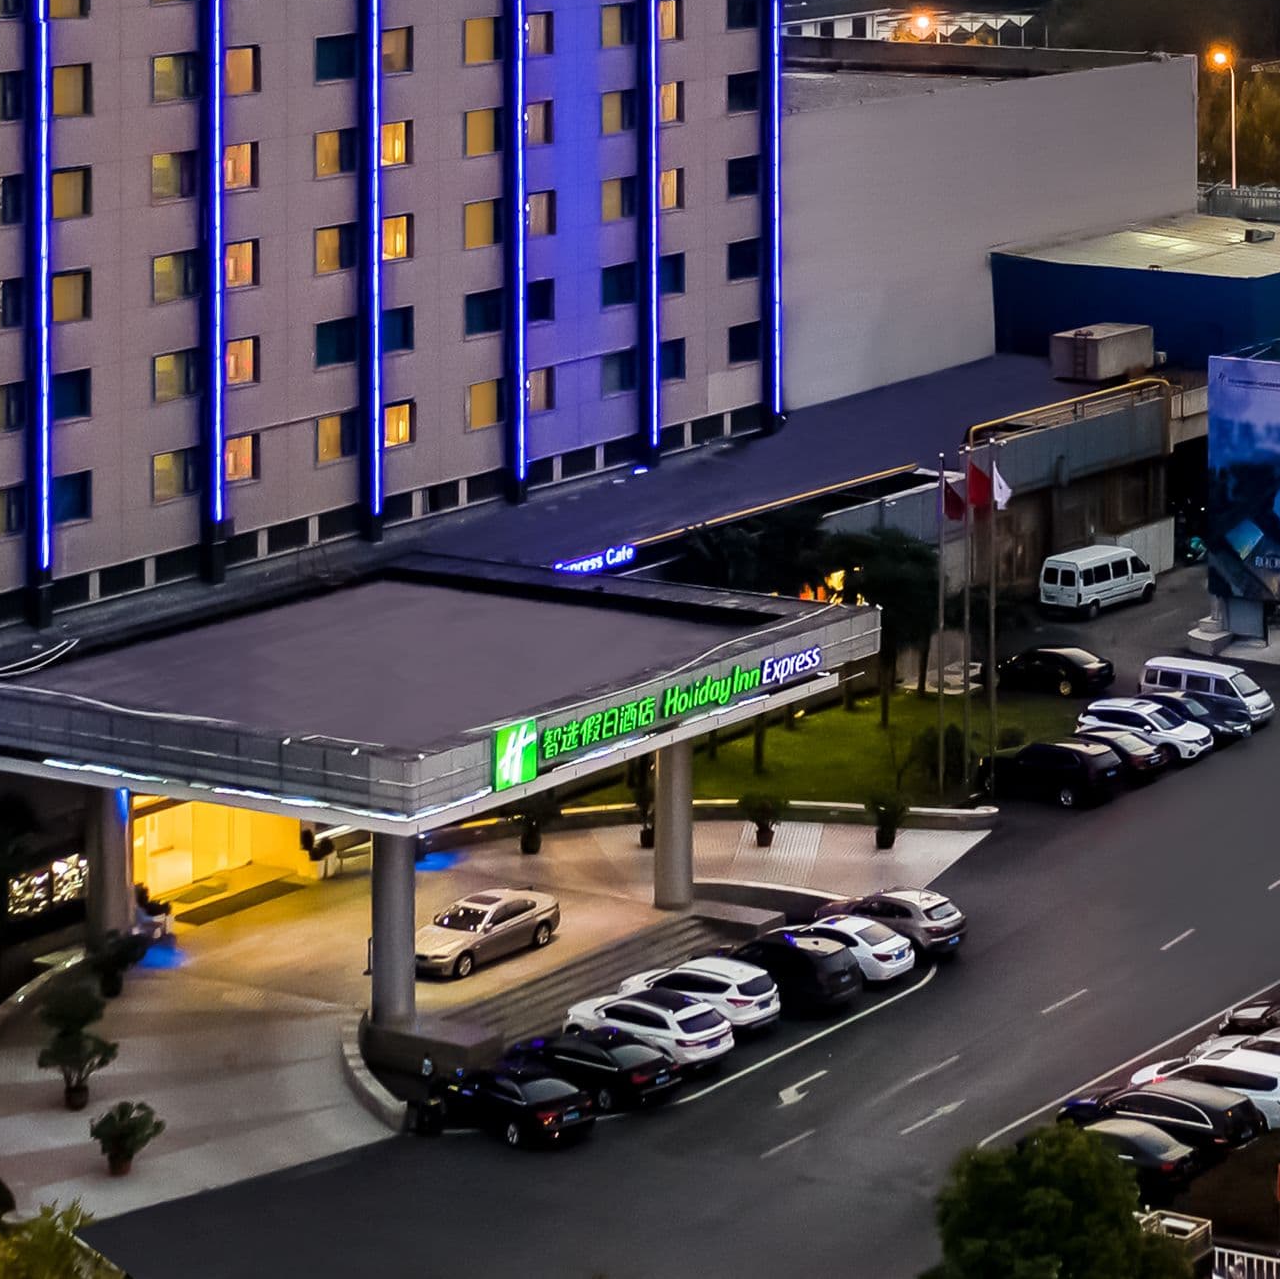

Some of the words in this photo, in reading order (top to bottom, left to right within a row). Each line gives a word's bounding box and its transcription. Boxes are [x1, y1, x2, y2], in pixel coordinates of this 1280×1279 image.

[663, 675, 733, 719] Holiday
[733, 665, 761, 694] Inn
[761, 646, 821, 684] Express
[542, 695, 657, 760] 智选假日酒店
